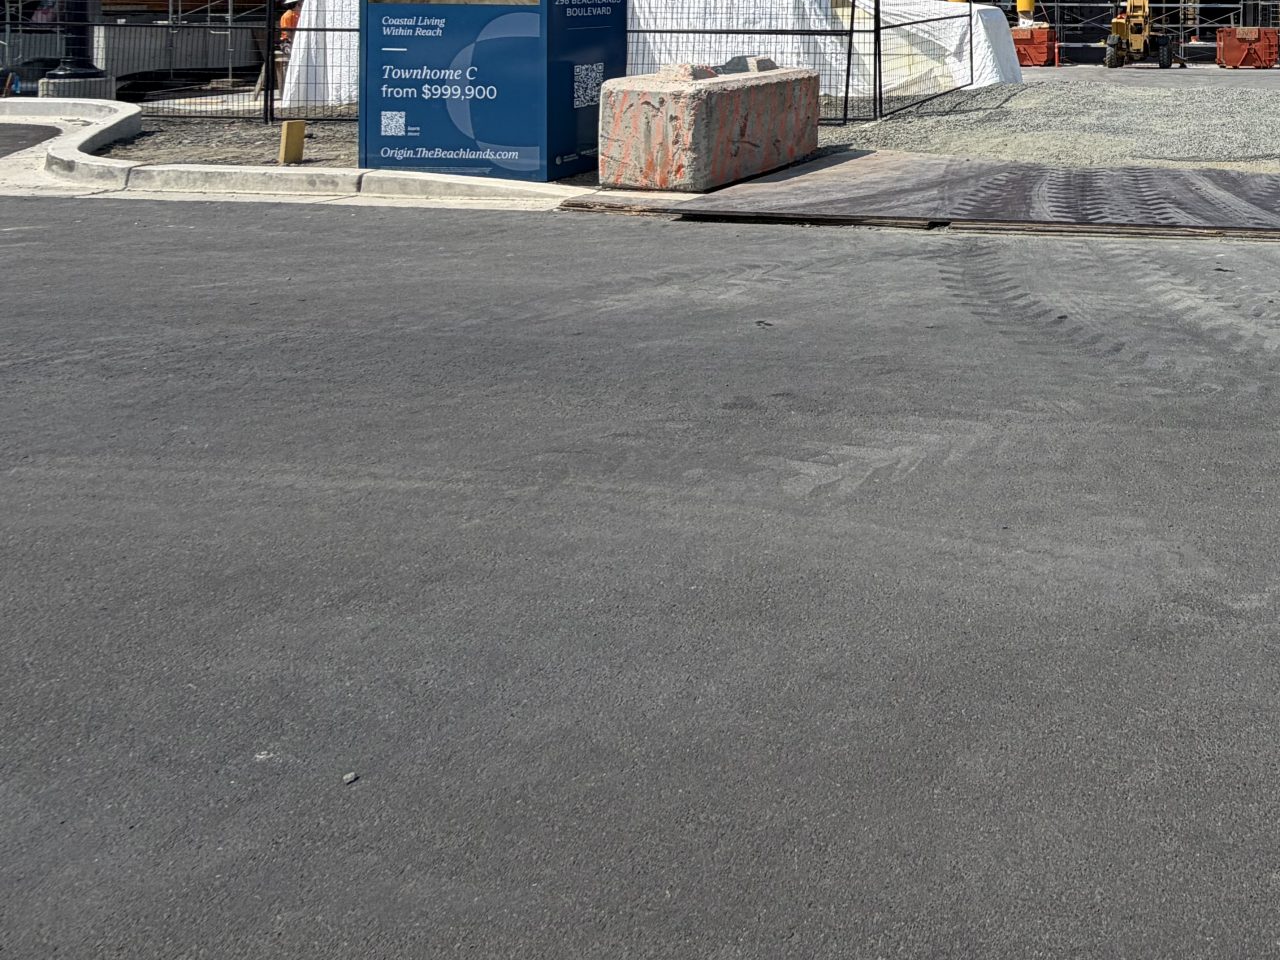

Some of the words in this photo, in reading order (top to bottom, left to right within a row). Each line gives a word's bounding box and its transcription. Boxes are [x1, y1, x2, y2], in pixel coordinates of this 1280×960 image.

[566, 6, 612, 17] BOULEVARD
[382, 16, 416, 26] Coastal
[417, 16, 446, 28] Living
[382, 26, 413, 36] Within
[414, 27, 443, 37] Reach
[382, 65, 462, 80] Townhome
[466, 66, 478, 80] C
[381, 84, 417, 98] from
[421, 83, 498, 101] $999,900
[380, 146, 519, 161] Origin.TheBeachlands.com
